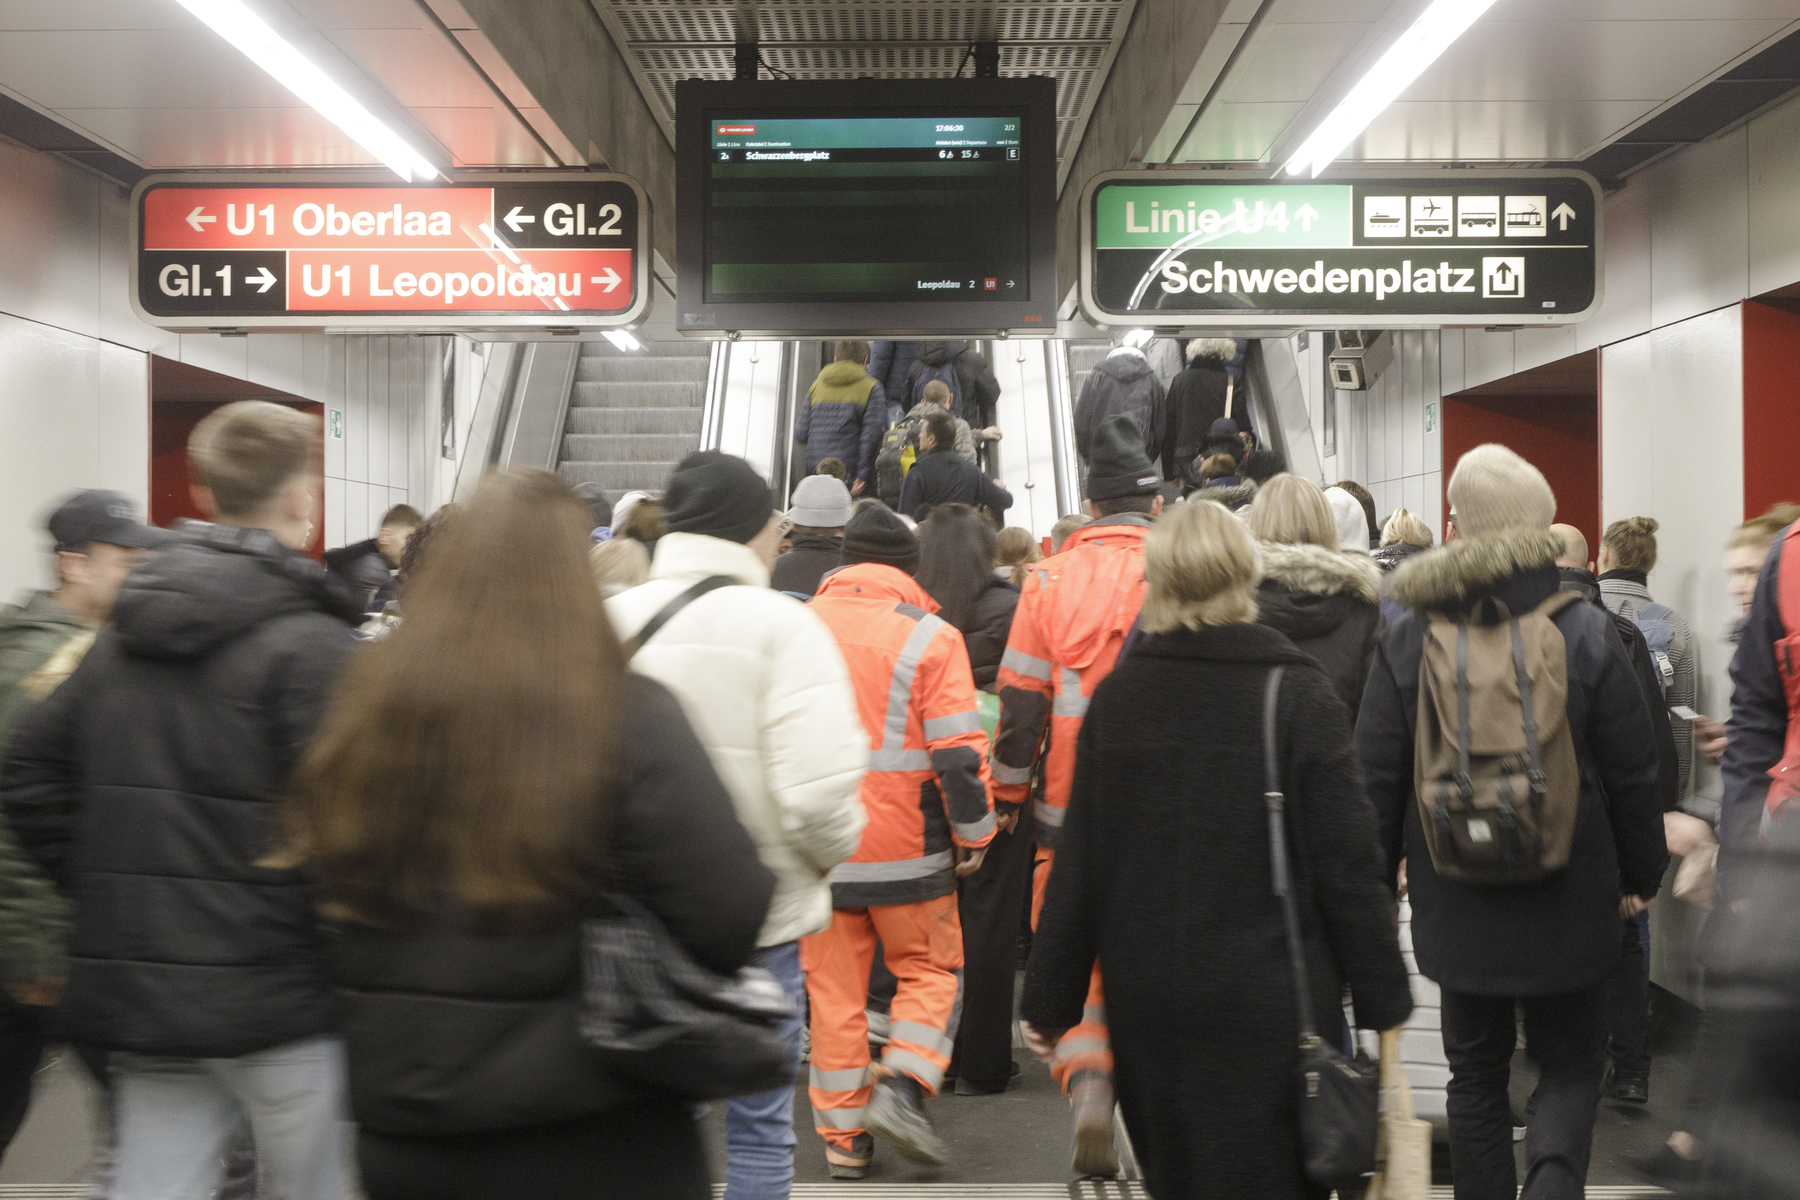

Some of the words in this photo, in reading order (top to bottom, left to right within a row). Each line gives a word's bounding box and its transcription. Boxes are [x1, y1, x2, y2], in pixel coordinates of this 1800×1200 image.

[745, 151, 830, 162] Schwarzenbergplatz
[938, 150, 946, 158] 6
[961, 150, 972, 158] 15
[1009, 150, 1016, 158] E
[227, 203, 275, 236] U1
[293, 203, 451, 236] Oberlaa
[543, 203, 622, 236] Gl.2
[1126, 201, 1222, 234] Linie
[1233, 201, 1289, 234] U4
[159, 264, 232, 297] Gl.1
[302, 264, 351, 297] U1
[370, 264, 581, 304] Leopoldau
[917, 280, 960, 290] Leopoldau
[969, 280, 976, 289] 2
[985, 280, 995, 288] U1
[1160, 260, 1475, 300] Schwedenplatz
